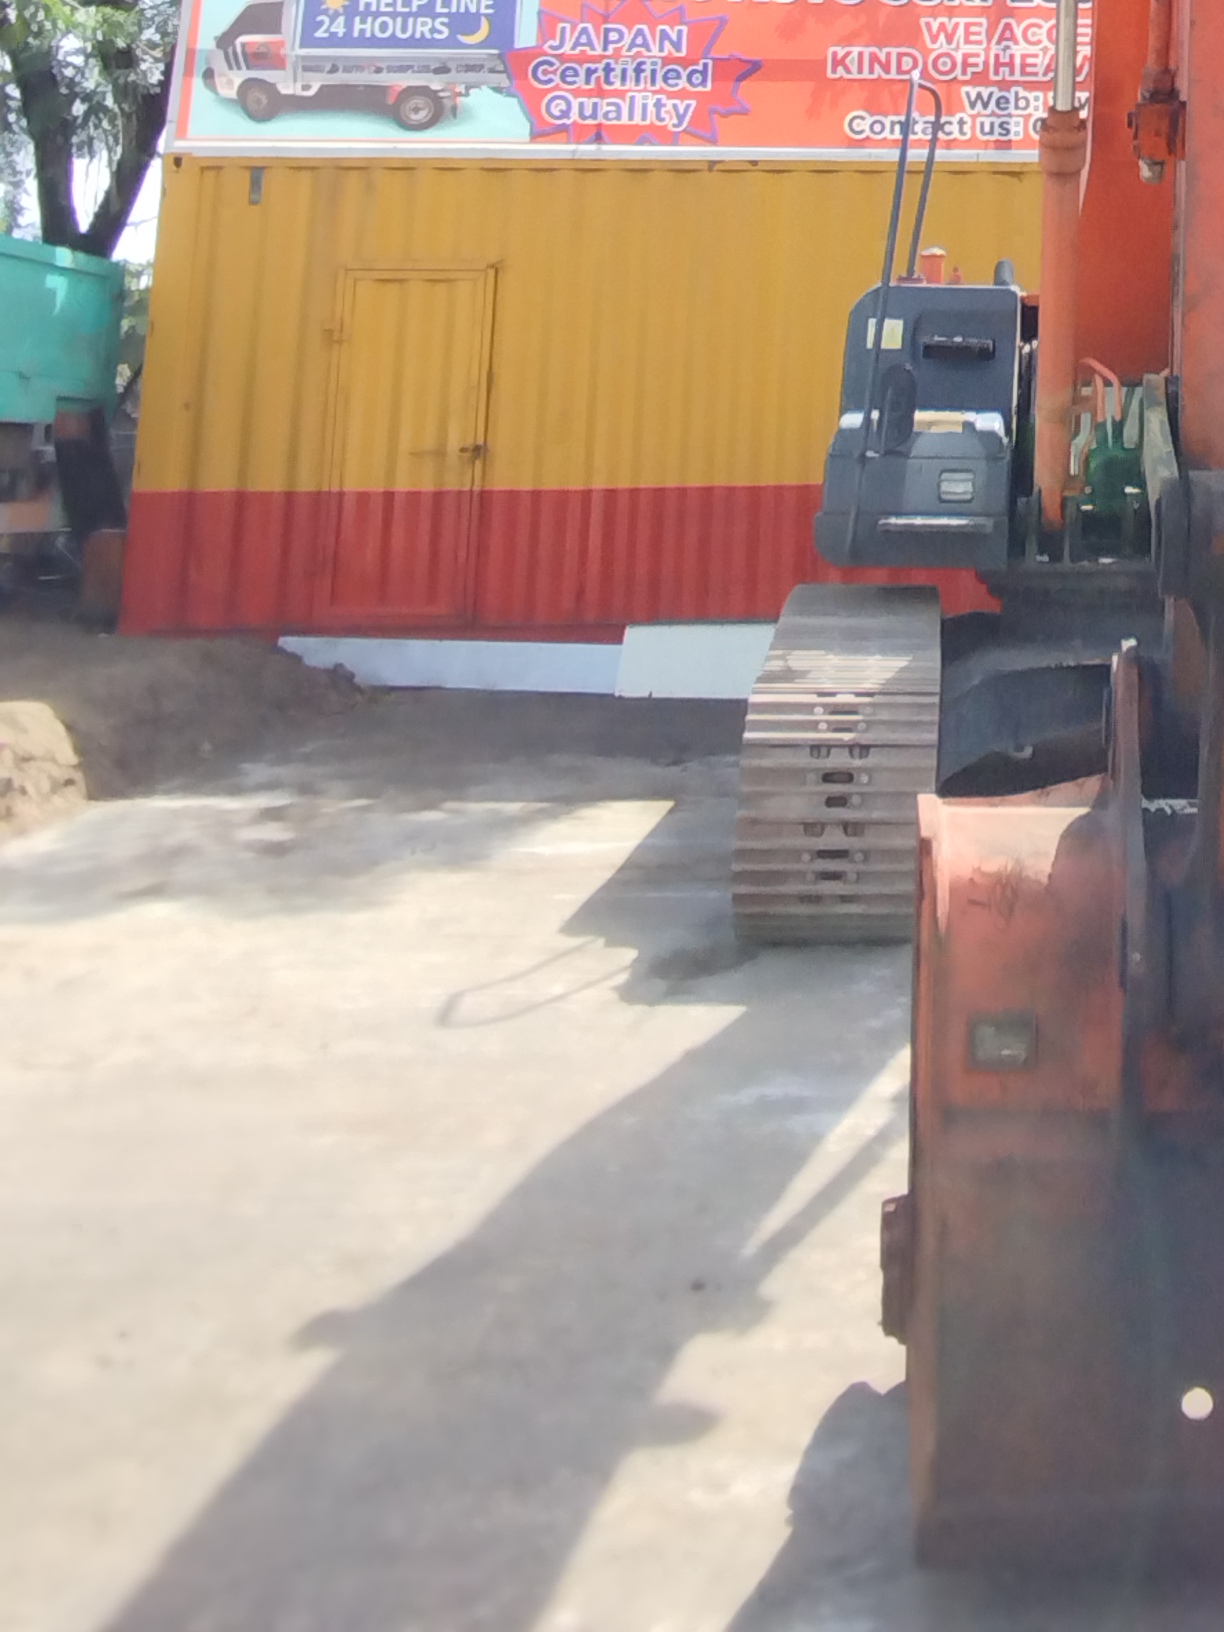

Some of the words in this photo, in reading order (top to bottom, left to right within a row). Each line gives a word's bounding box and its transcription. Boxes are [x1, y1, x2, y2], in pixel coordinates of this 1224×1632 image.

[313, 15, 346, 38] 24
[352, 16, 450, 40] HOURS
[545, 24, 685, 55] JAPAN
[922, 19, 985, 47] WE
[530, 57, 710, 90] Certified
[829, 48, 920, 77] KIND
[929, 50, 984, 79] OF
[543, 93, 694, 129] Quality
[963, 88, 1041, 114] Web:
[846, 113, 969, 138] Contact
[978, 119, 1022, 139] us:
